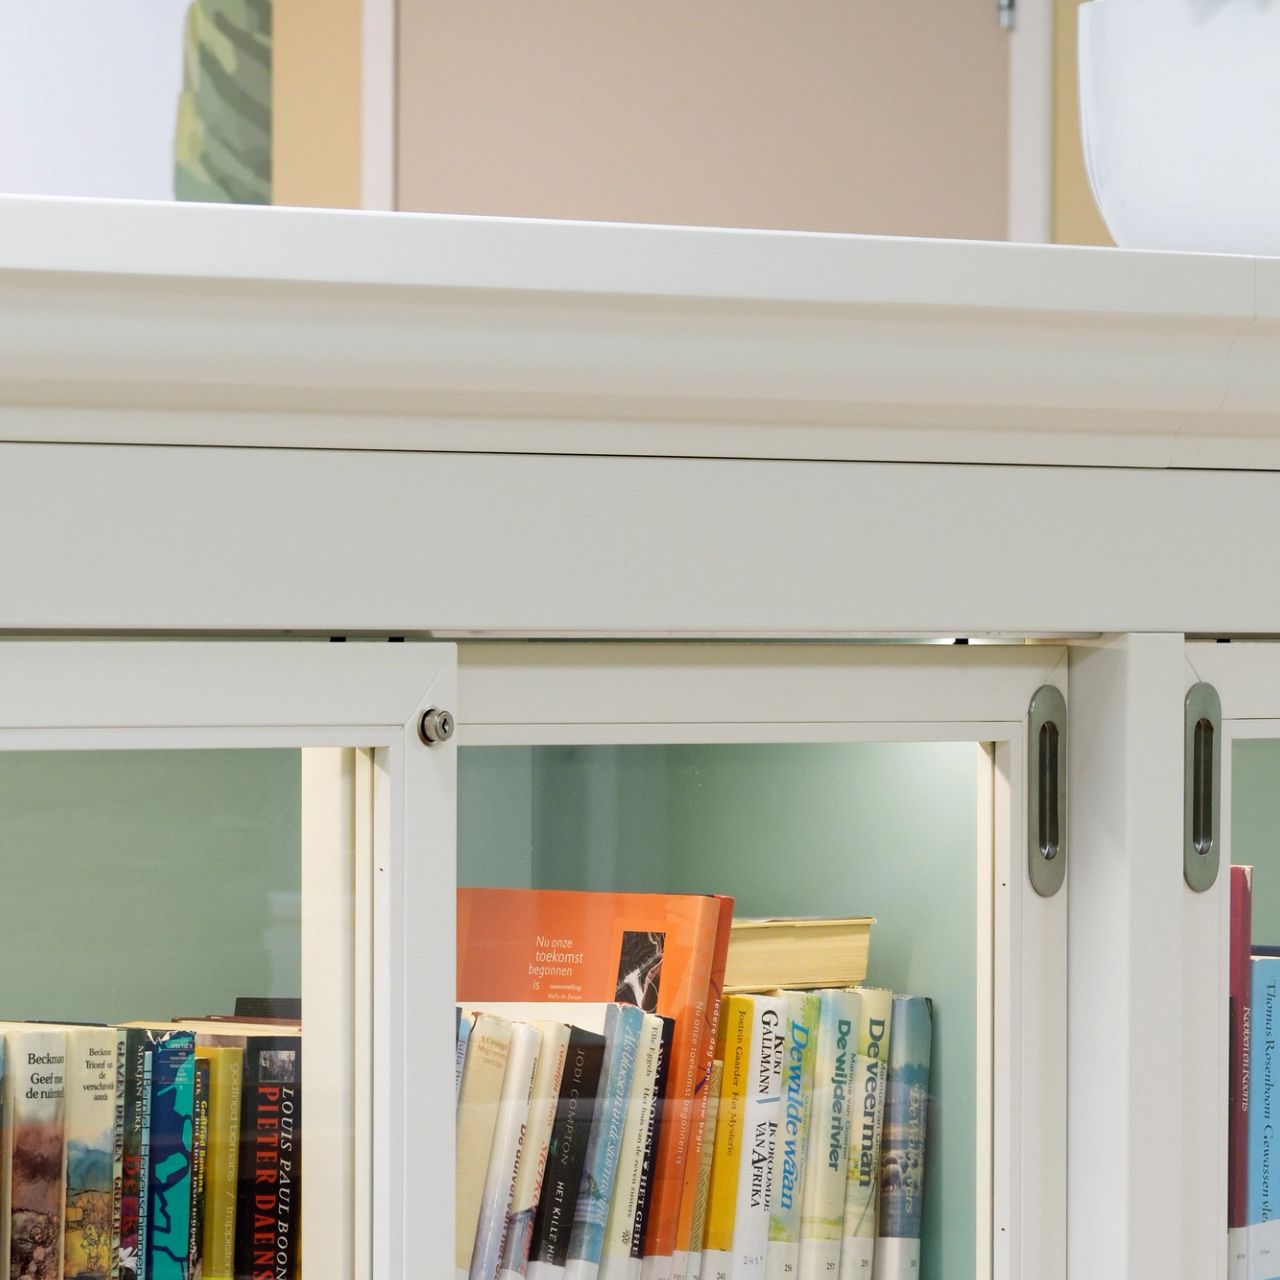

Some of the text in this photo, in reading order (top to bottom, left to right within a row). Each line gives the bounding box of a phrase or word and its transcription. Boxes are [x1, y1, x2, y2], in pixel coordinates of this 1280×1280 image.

[535, 950, 584, 964] toekomst
[536, 936, 573, 949] Nu onze
[528, 963, 572, 978] begonnen
[532, 980, 540, 990] is
[1265, 981, 1277, 1036] Thomas
[27, 1053, 65, 1065] Beckman
[572, 1047, 585, 1082] JODI
[758, 1009, 780, 1095] GALLMANN
[772, 1035, 786, 1075] KUKI
[25, 1088, 39, 1099] de
[30, 1073, 53, 1085] Geef
[98, 1072, 106, 1080] de
[133, 1045, 145, 1133] MARJAN BERK
[725, 1009, 747, 1156] Jostein Gaarder Het Mysterie
[827, 1019, 851, 1172] De wijde rivier
[1263, 1039, 1276, 1119] Rosenboom
[279, 1087, 294, 1152] LOUIS
[858, 1018, 886, 1188] De veerman
[255, 1085, 280, 1185] PIETER
[559, 1088, 580, 1166] COMPTON
[750, 1120, 768, 1208] VAN AFRIKA
[763, 1120, 779, 1212] IK DROOMDE
[1261, 1124, 1274, 1198] Gewassen
[278, 1158, 292, 1214] PAUL
[554, 1181, 566, 1203] HET
[549, 1207, 562, 1242] KILLE
[546, 1244, 556, 1264] HU
[783, 1263, 793, 1273] 256
